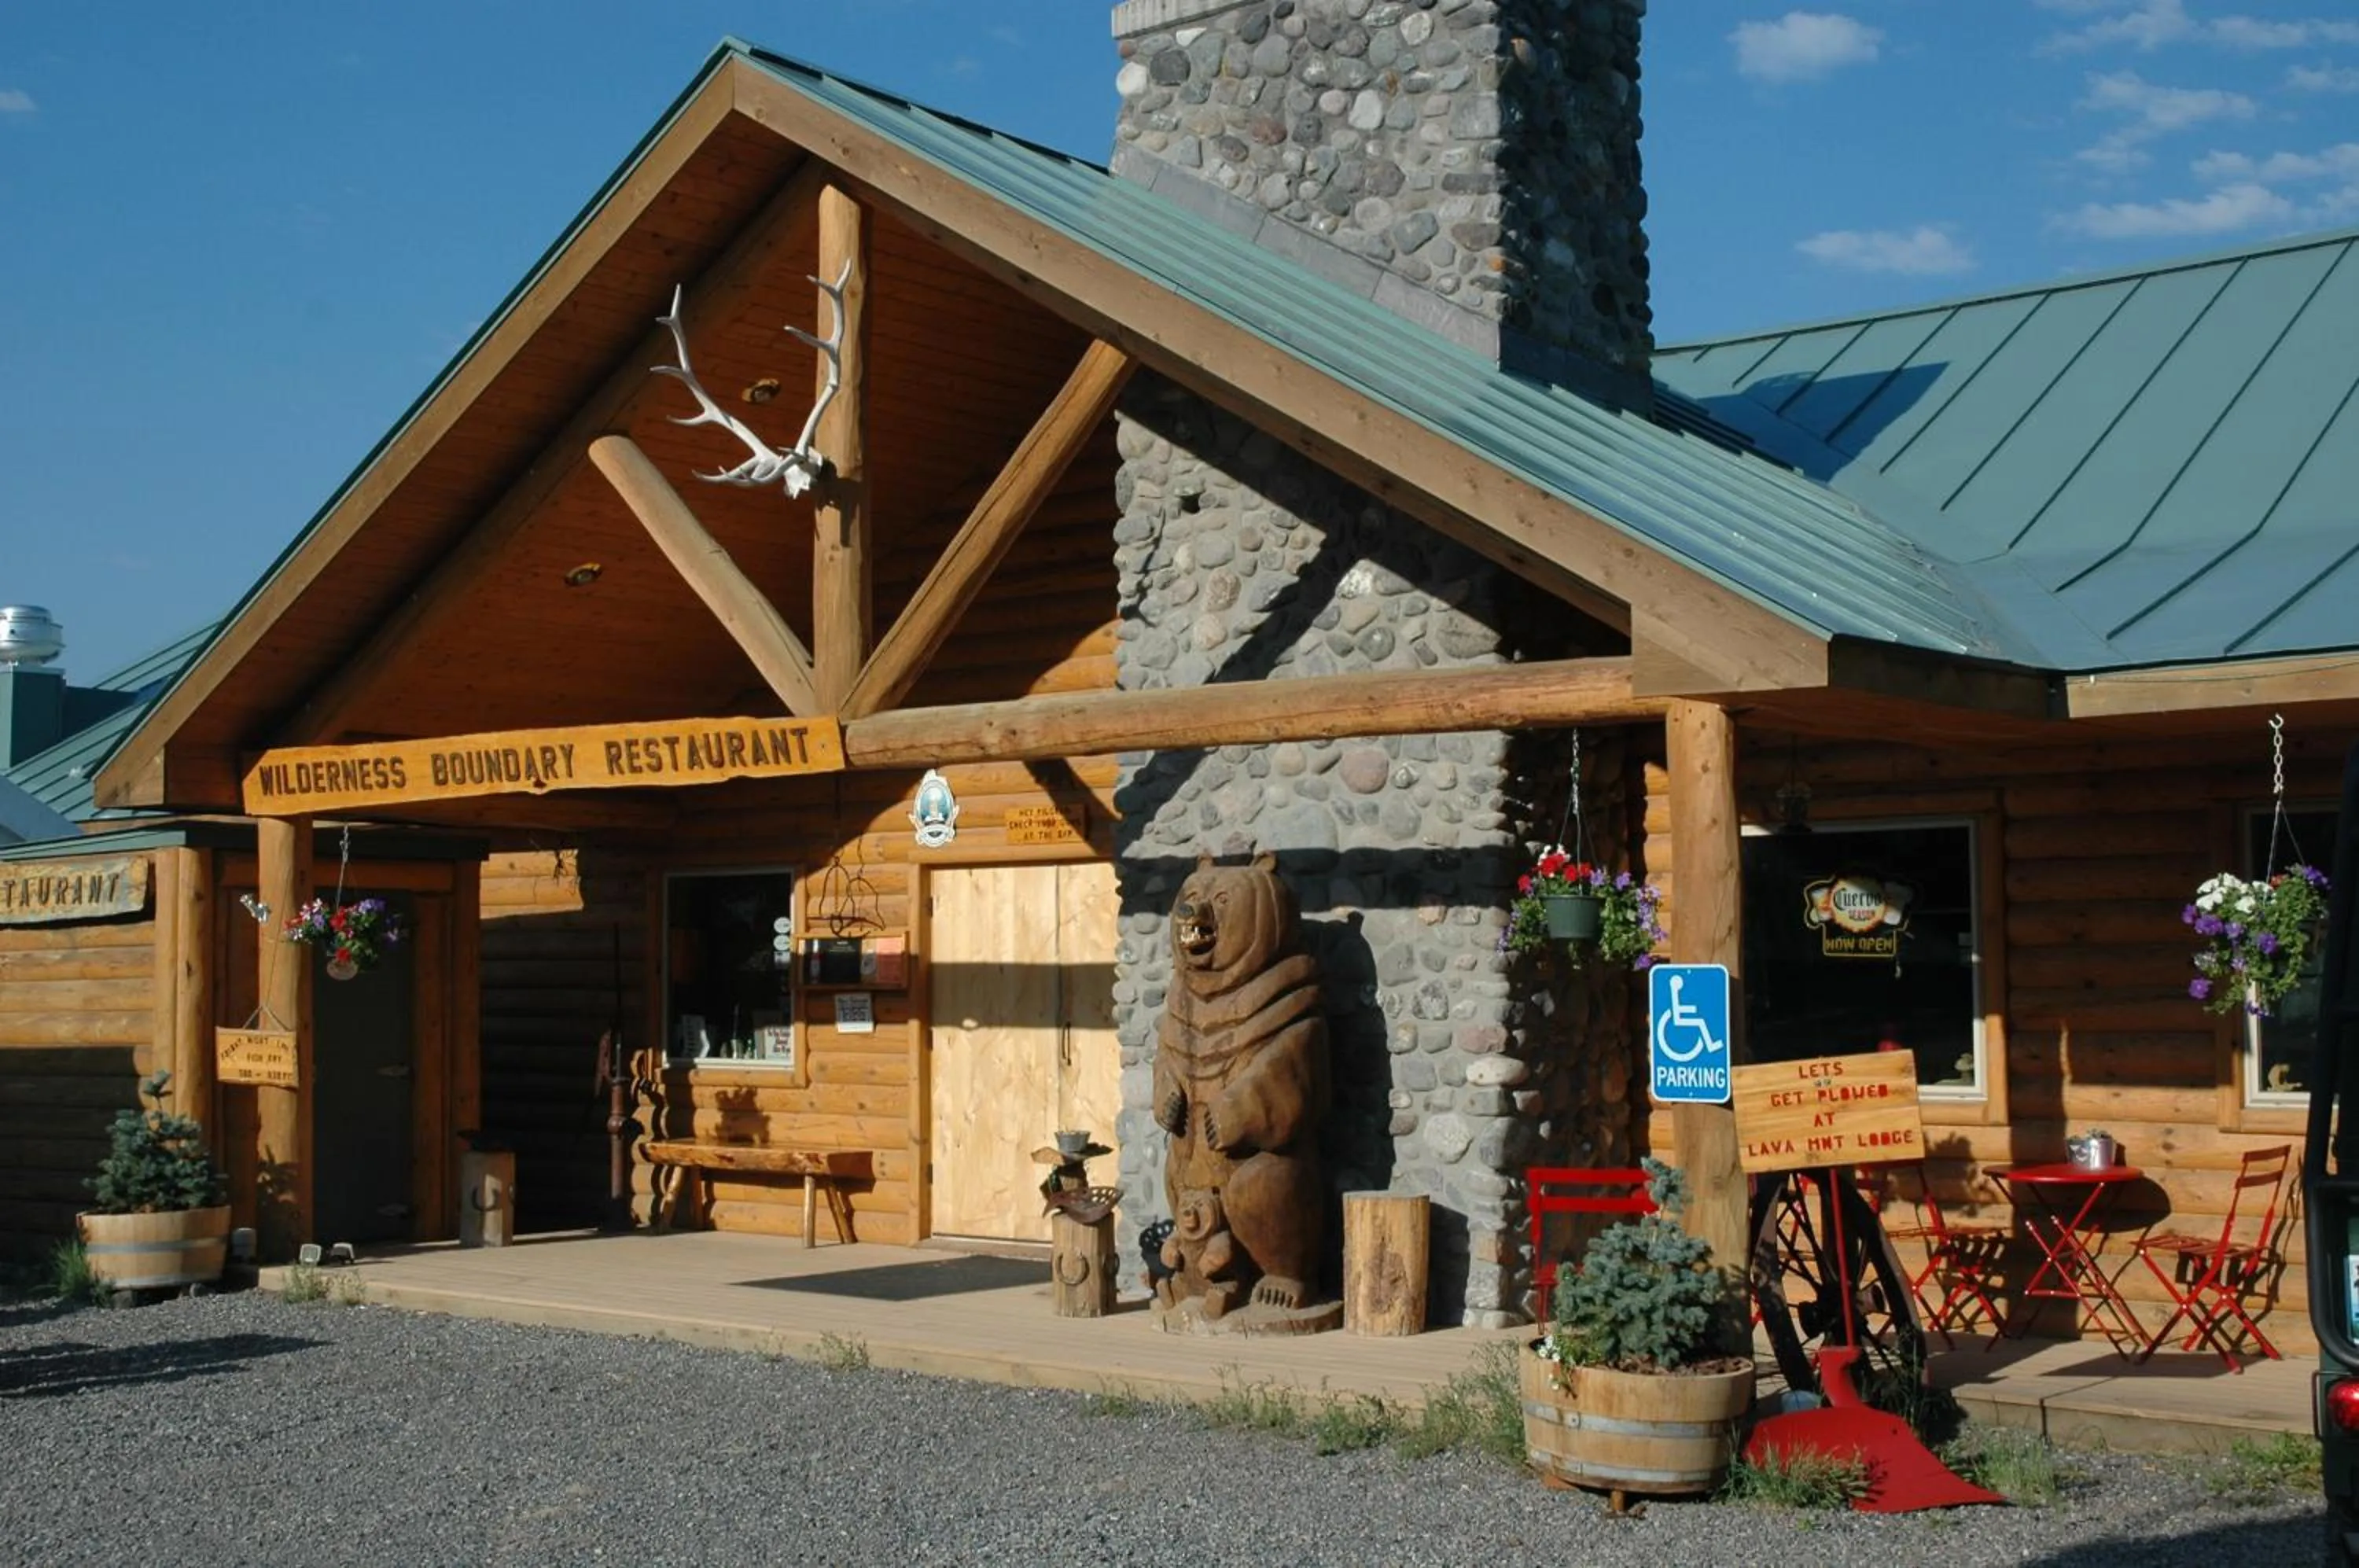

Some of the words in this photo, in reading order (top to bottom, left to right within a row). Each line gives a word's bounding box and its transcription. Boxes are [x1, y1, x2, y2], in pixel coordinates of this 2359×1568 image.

[259, 756, 407, 797] WILDERNESS
[430, 744, 574, 787] BOUNDARY
[604, 727, 808, 775] RESTAURANT
[1825, 937, 1855, 951] NOW
[1858, 937, 1893, 951] OPEN
[1657, 1066, 1725, 1088] PARKING
[1799, 1062, 1843, 1080] LETS
[1771, 1091, 1804, 1107] GET
[1817, 1084, 1888, 1102] PLOWED
[1814, 1112, 1835, 1128] AT
[1748, 1143, 1794, 1158] LAVA
[1808, 1135, 1845, 1152] MNT
[1858, 1129, 1913, 1148] LODGE
